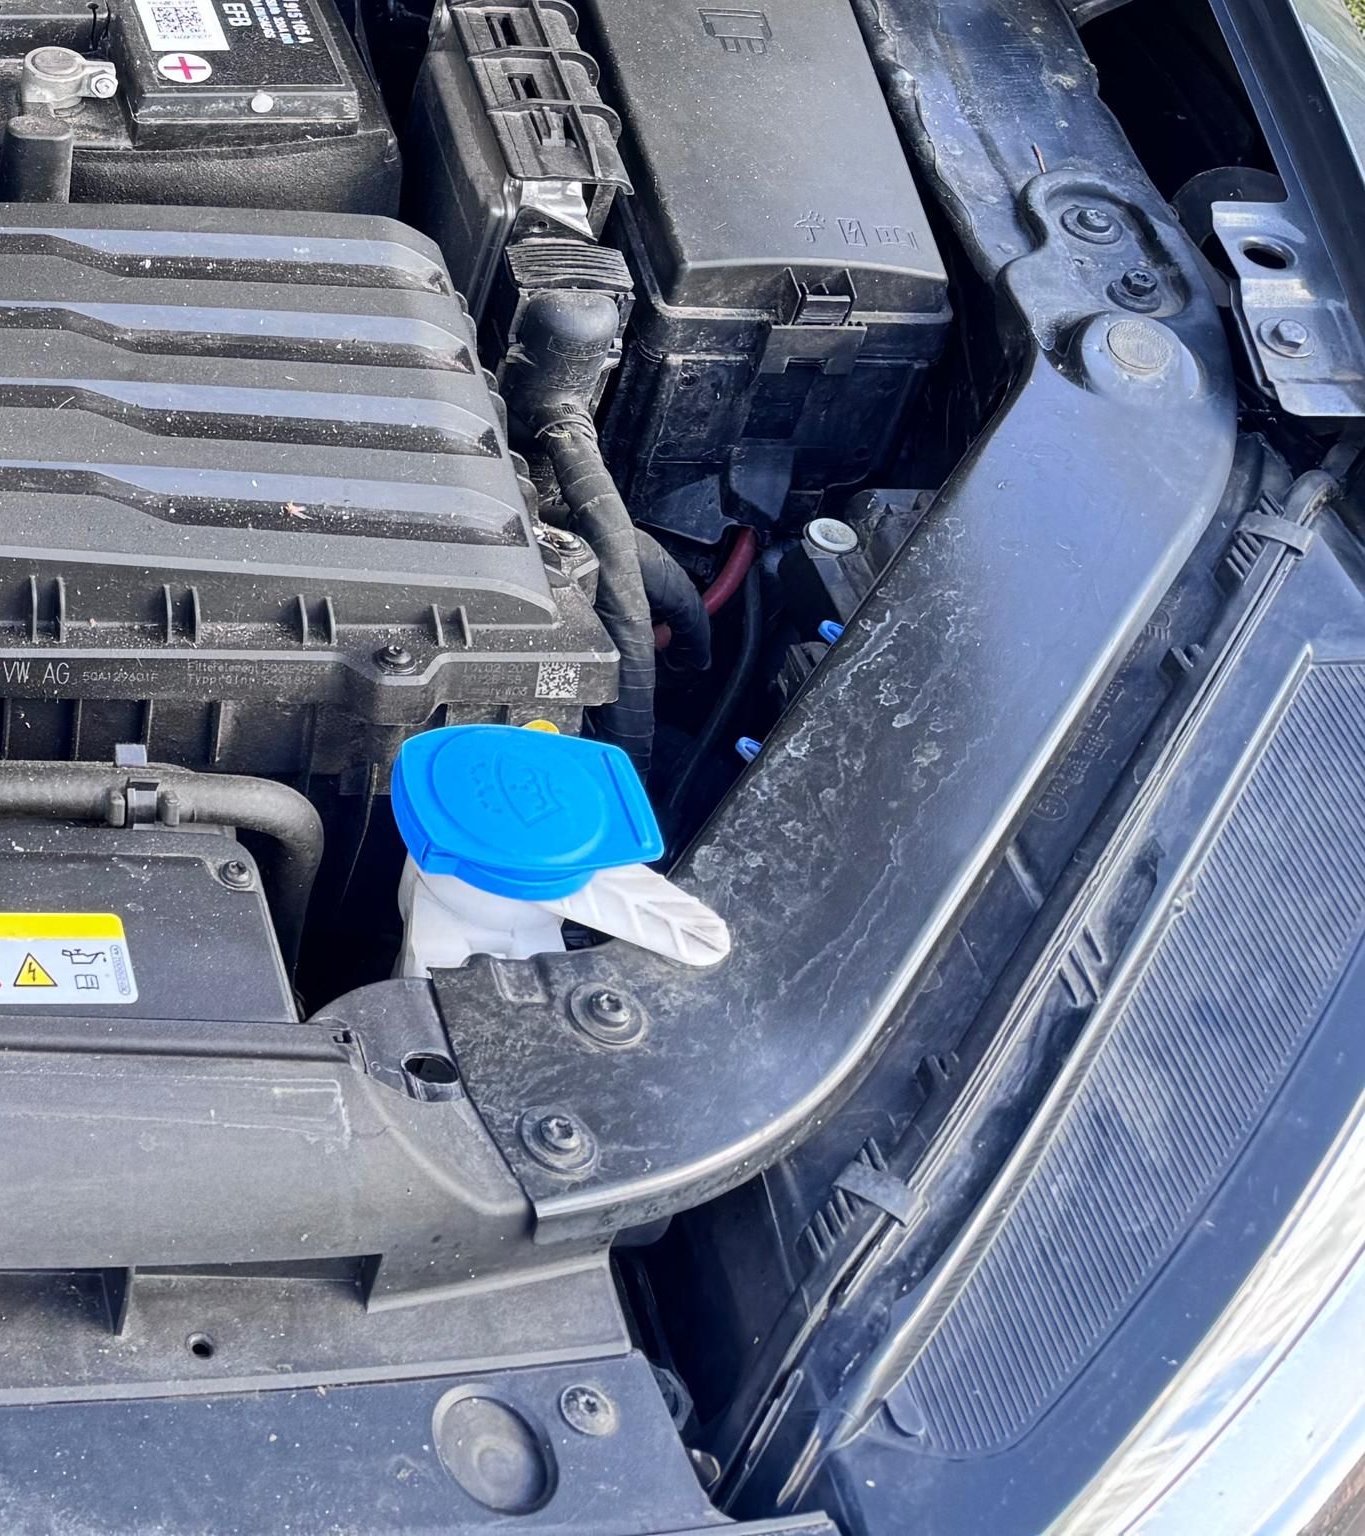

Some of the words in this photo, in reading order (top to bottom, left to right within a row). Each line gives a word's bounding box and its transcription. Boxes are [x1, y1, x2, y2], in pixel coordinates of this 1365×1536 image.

[222, 3, 252, 27] EFB
[3, 661, 29, 685] VW
[42, 662, 70, 685] AG
